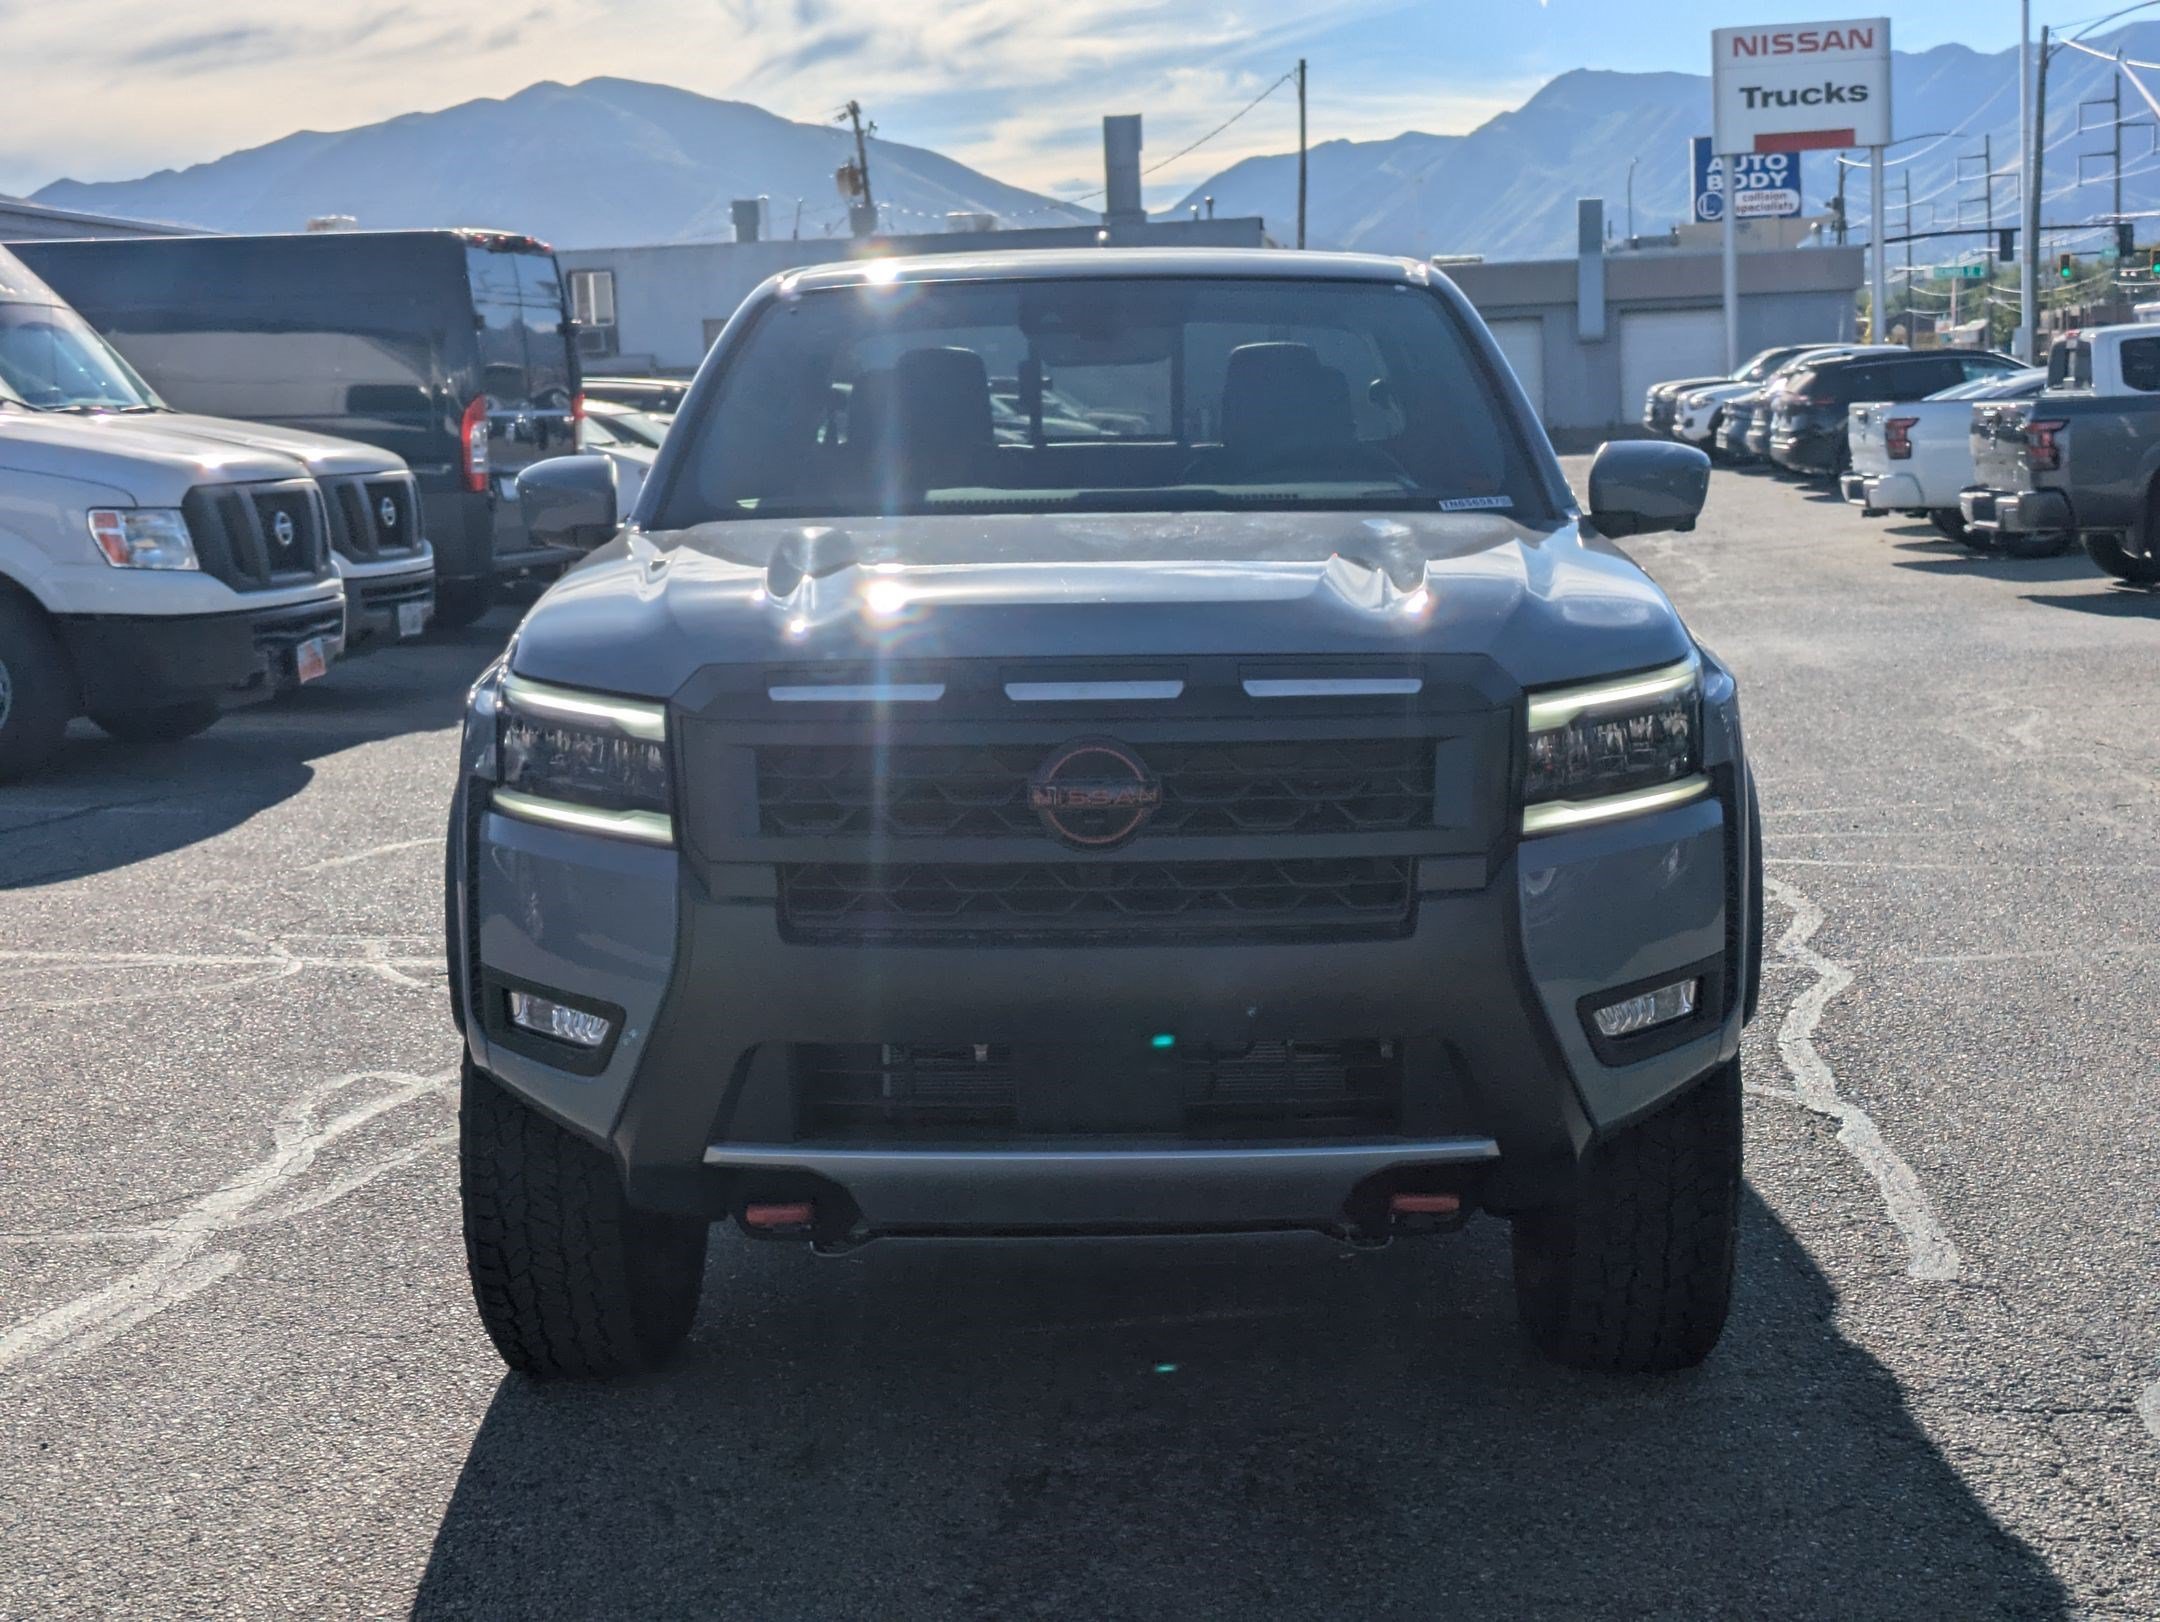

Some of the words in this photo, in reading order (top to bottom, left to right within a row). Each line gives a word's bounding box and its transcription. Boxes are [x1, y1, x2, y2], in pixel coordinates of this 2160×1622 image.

[1733, 27, 1873, 57] NISSAN
[1739, 82, 1869, 109] Trucks
[1742, 191, 1787, 202] collision
[1031, 785, 1158, 806] NISSAN
